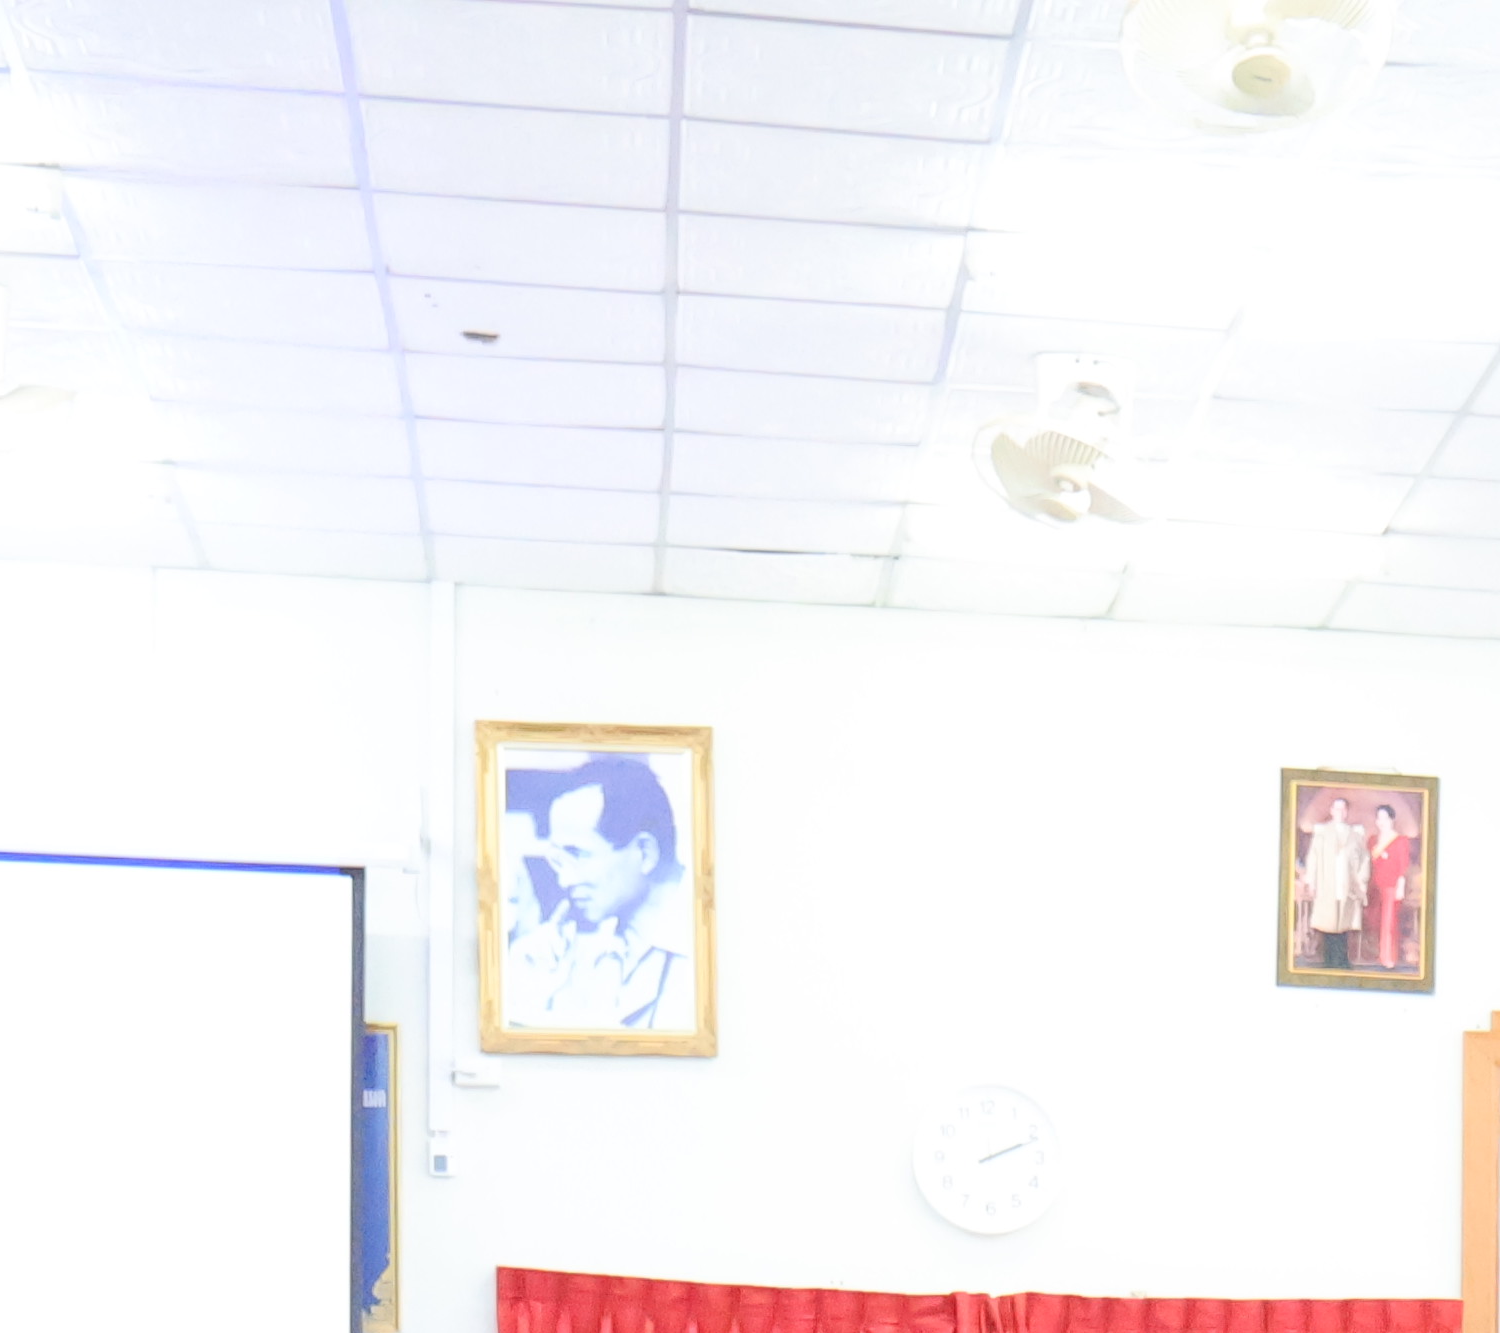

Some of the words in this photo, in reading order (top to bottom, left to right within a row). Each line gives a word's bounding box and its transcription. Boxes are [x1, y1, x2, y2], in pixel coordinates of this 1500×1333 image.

[957, 1105, 971, 1120] 11
[979, 1097, 997, 1116] 12
[1011, 1105, 1018, 1120] 1
[939, 1122, 957, 1138] 10
[1027, 1123, 1040, 1141] 2
[933, 1150, 946, 1165] 9
[1033, 1150, 1045, 1166] 3
[941, 1174, 954, 1191] 8
[1027, 1173, 1041, 1190] 4
[960, 1192, 971, 1208] 7
[1010, 1192, 1023, 1209] 5
[984, 1200, 997, 1217] 6
